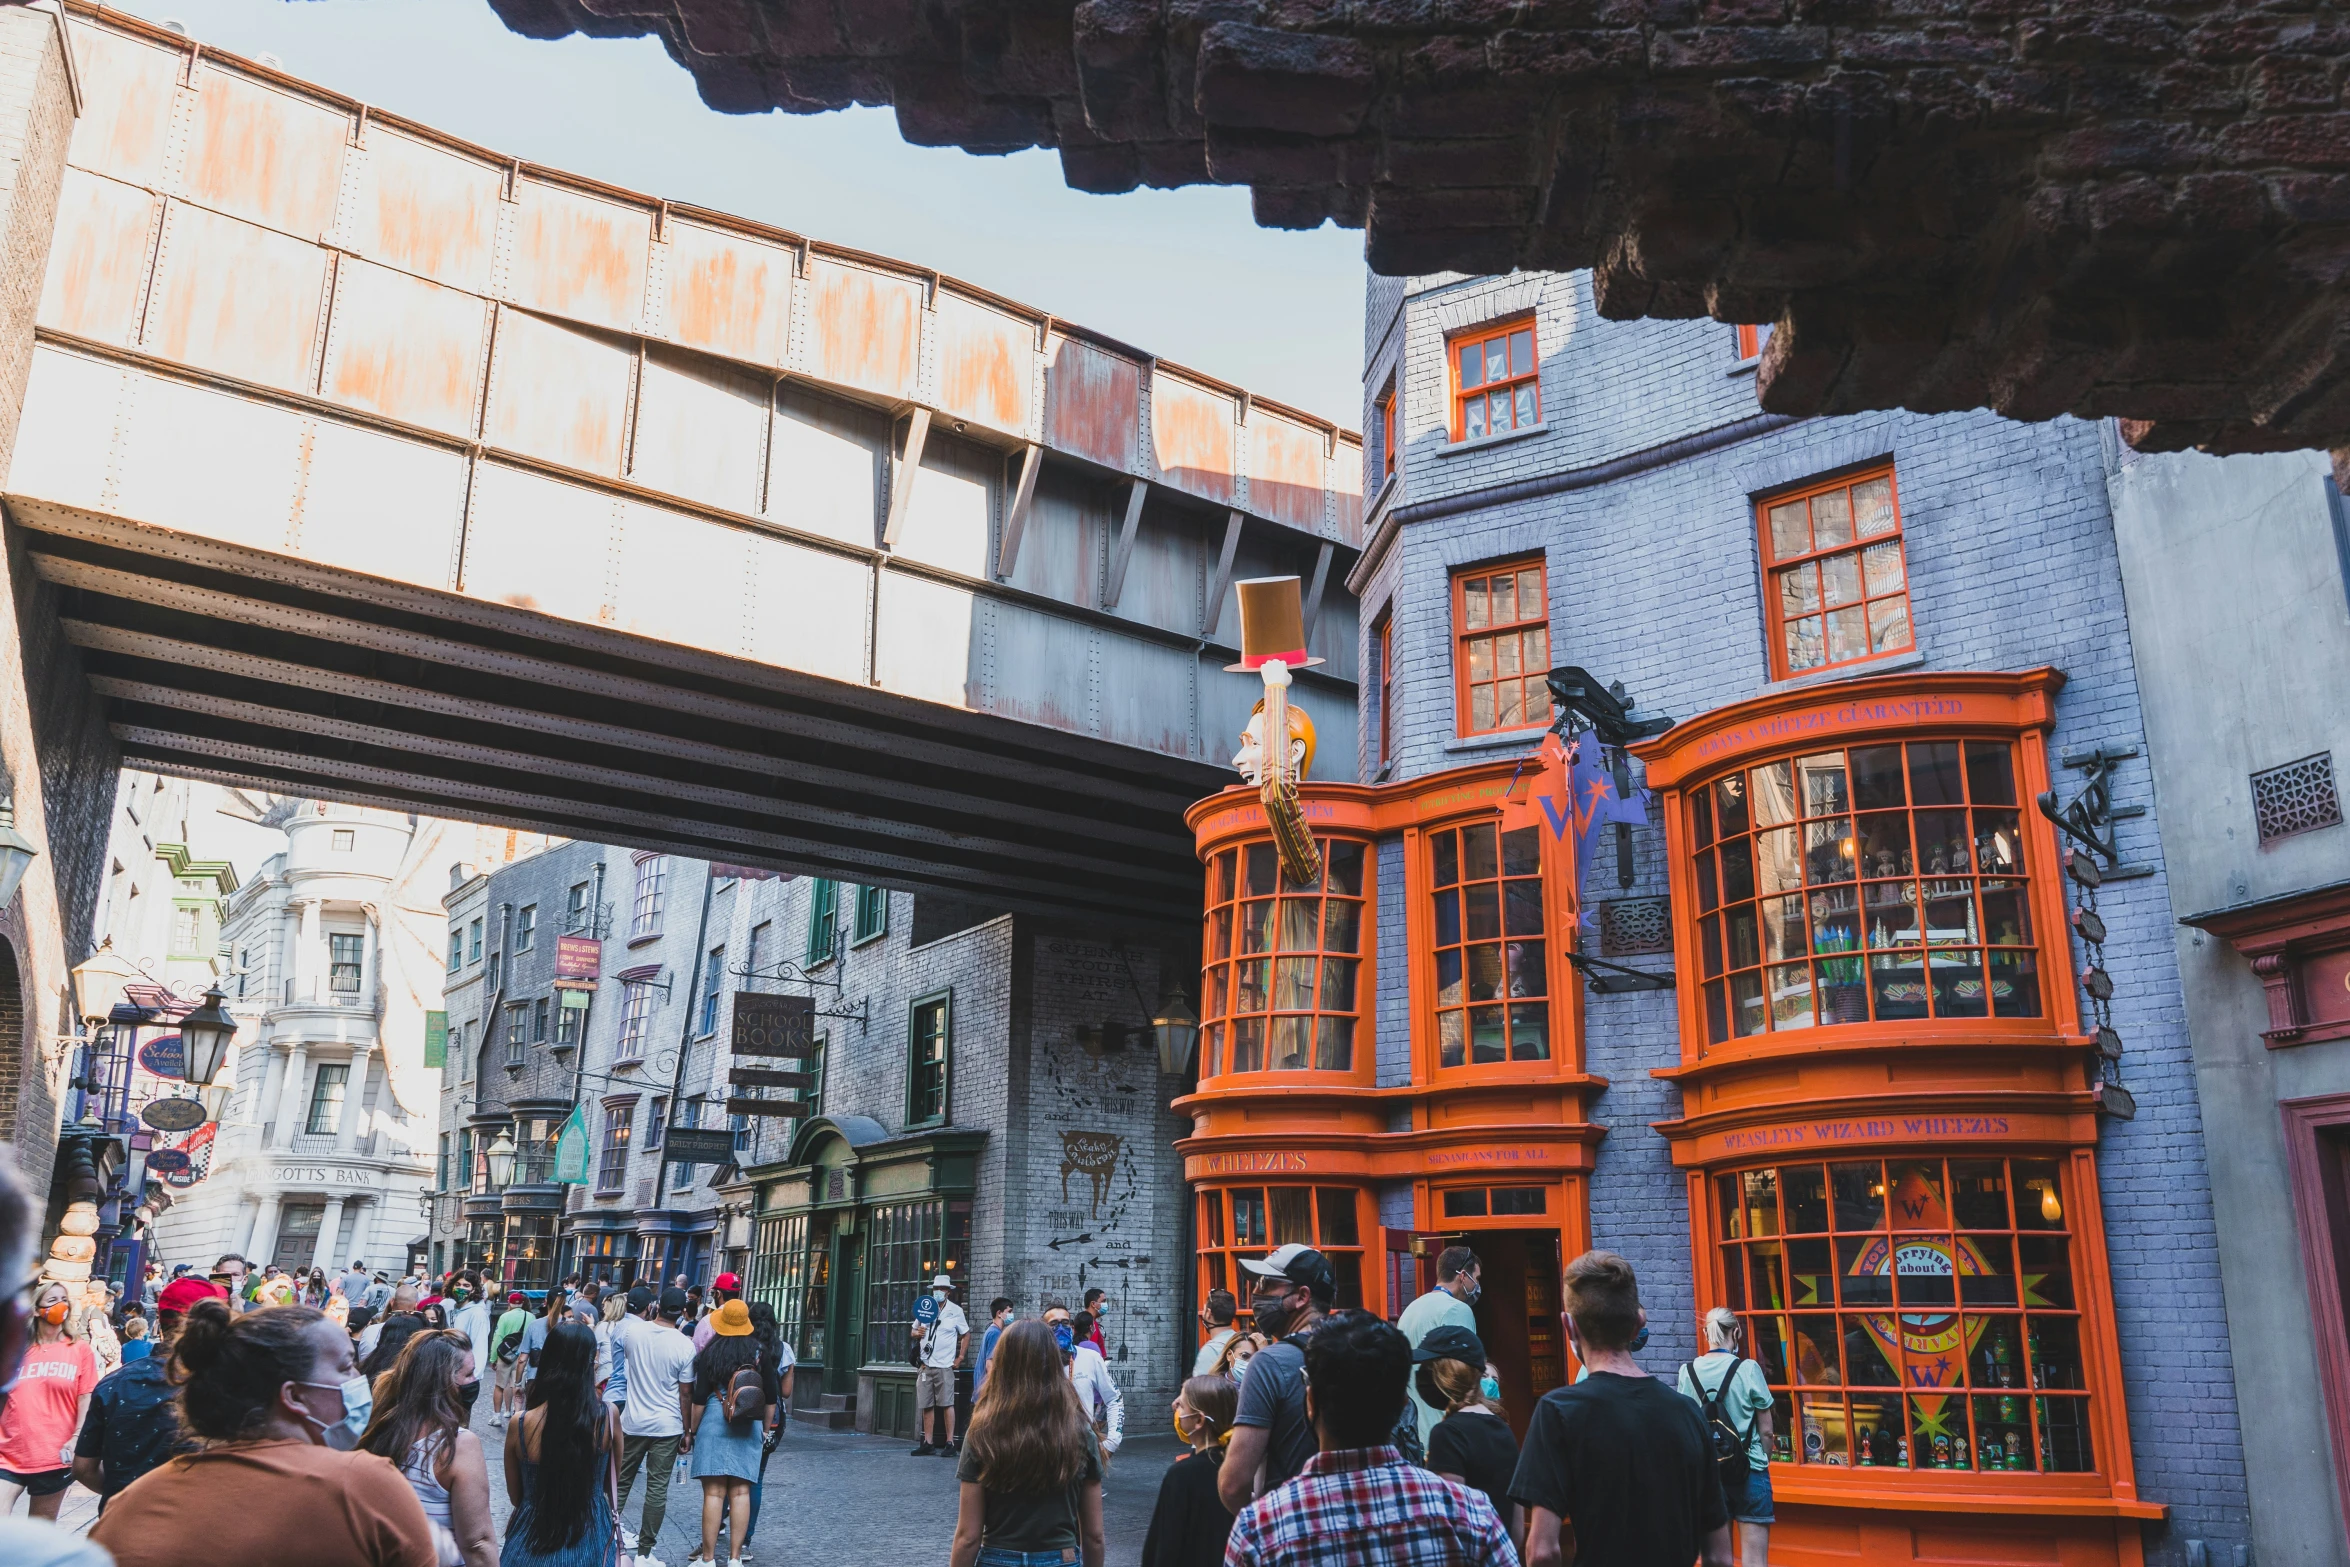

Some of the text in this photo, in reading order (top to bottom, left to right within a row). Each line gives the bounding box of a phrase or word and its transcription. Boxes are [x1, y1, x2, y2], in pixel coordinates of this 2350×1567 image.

[1697, 700, 1963, 757] ALWAYS A WHEEZE GUARANTEED
[560, 942, 578, 952] BREWS
[582, 945, 599, 954] STEWS
[1049, 943, 1145, 962] QUENCH
[1064, 959, 1130, 975] YOUR
[1053, 972, 1139, 990] THIRST
[1079, 989, 1109, 1001] AT
[754, 1000, 796, 1012] HOGWARTS
[738, 1011, 811, 1030] SCHOOL
[736, 1027, 811, 1049] BOOKS
[153, 1059, 184, 1067] Availab
[1100, 1096, 1135, 1116] THIS WAY
[1044, 1112, 1070, 1121] and
[1723, 1117, 2009, 1149] WEASLEYS' WIZARD WHEEZES
[668, 1140, 729, 1151] DAILY PROPHET
[1077, 1137, 1113, 1153] Leaky
[1206, 1152, 1307, 1173] WHEEZES
[1428, 1149, 1548, 1164] SHENANIGANS FOR ALL
[172, 1175, 191, 1183] INSIDE
[335, 1168, 371, 1185] BANK
[1049, 1211, 1085, 1230] THIS WAY
[1105, 1240, 1132, 1249] and
[1863, 1243, 1976, 1272] YOU BE
[1900, 1264, 1936, 1273] about
[1040, 1275, 1071, 1290] THE
[1904, 1335, 1941, 1350] ARE
[17, 1361, 78, 1382] LEMSON
[1120, 1369, 1136, 1387] WAY
